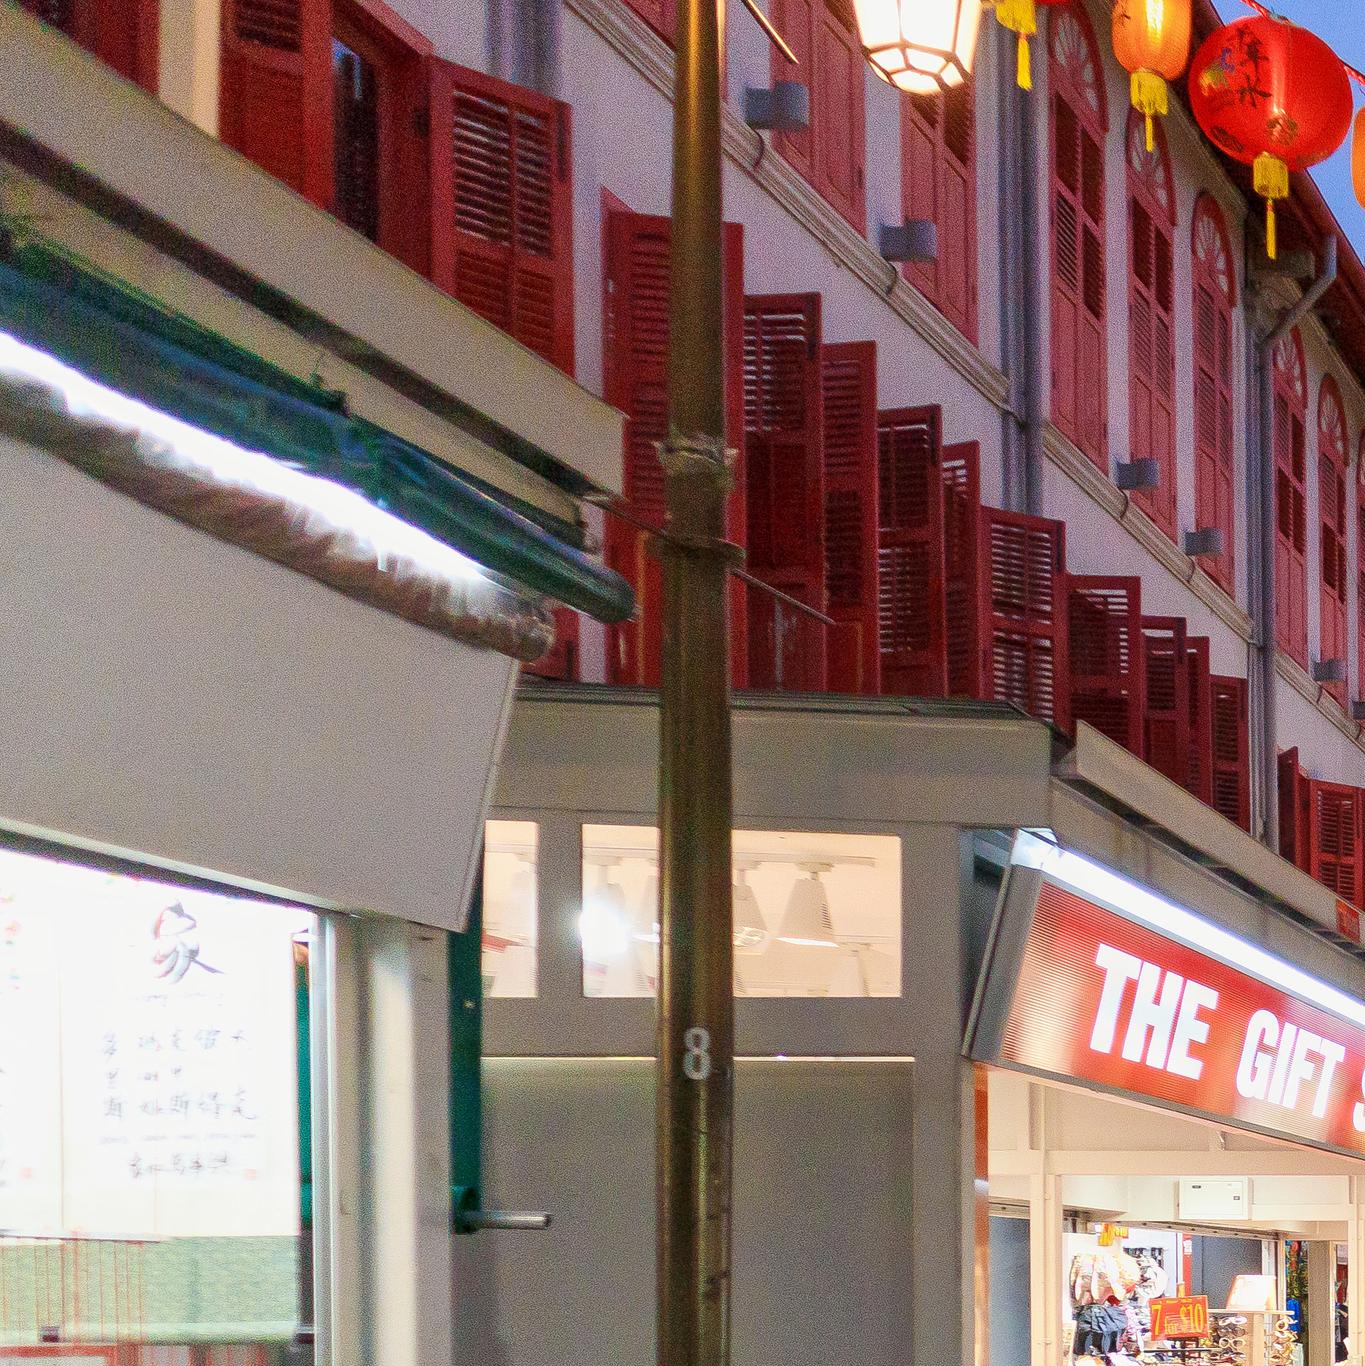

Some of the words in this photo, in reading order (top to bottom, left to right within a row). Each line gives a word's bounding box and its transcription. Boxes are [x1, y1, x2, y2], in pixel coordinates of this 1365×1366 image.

[683, 1026, 711, 1081] 8
[1089, 942, 1219, 1081] THE
[1236, 1009, 1346, 1118] GIFT
[1151, 1303, 1164, 1336] 7
[1180, 1302, 1204, 1336] $10
